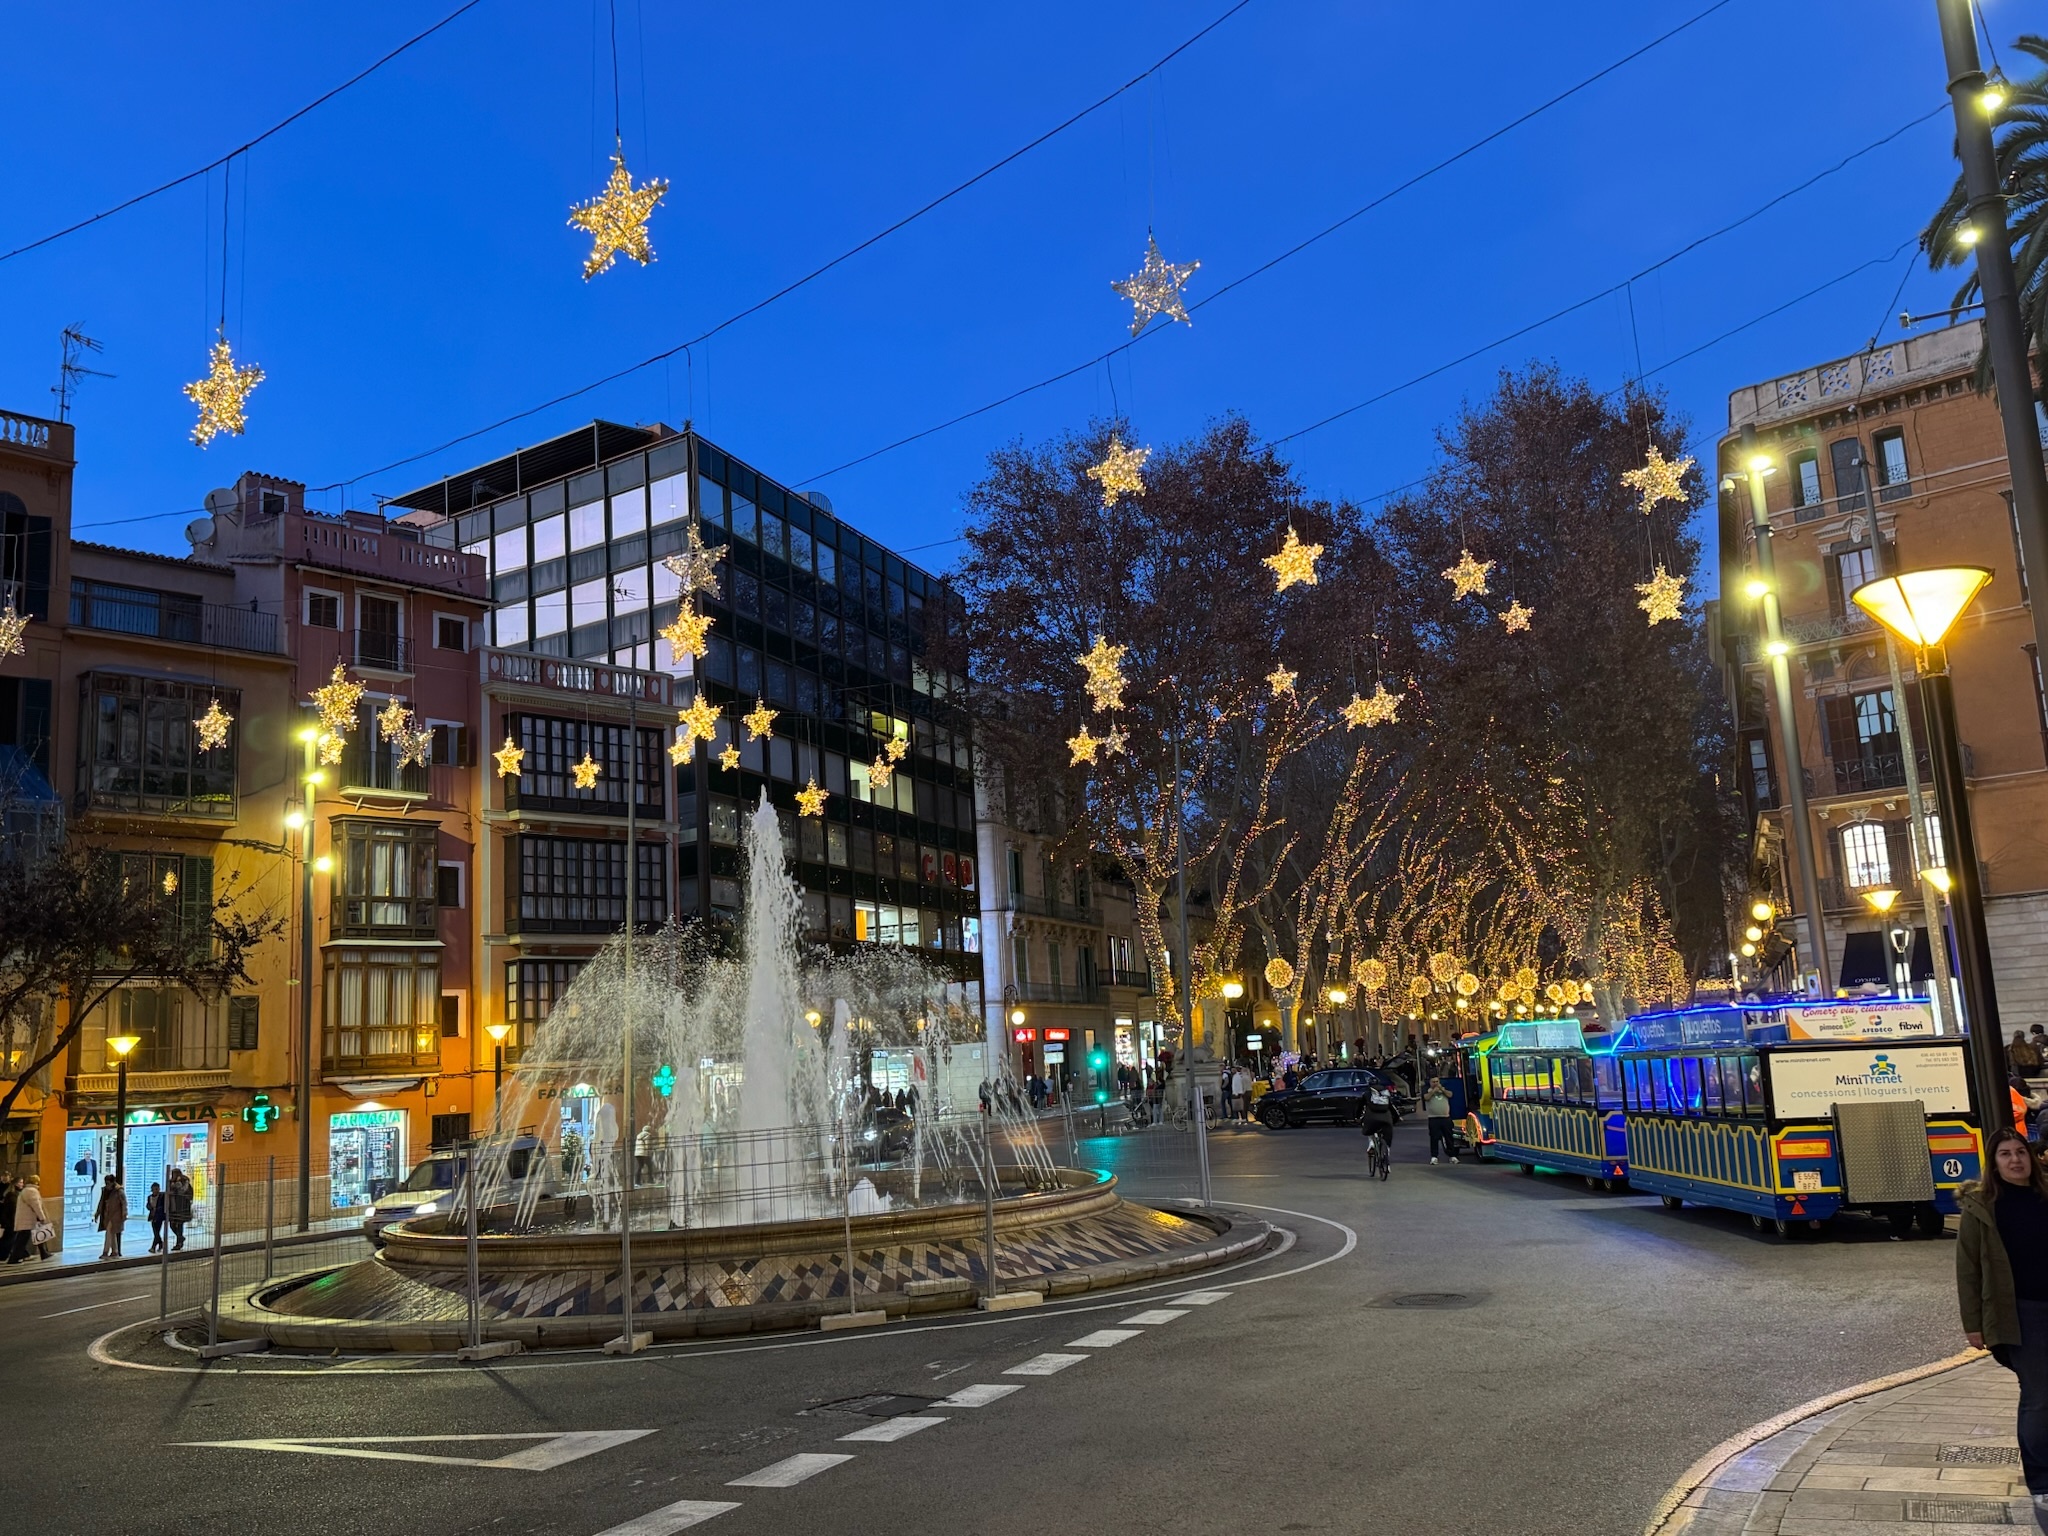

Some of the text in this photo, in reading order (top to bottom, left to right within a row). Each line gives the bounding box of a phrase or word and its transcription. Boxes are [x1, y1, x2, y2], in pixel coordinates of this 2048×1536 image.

[1802, 1006, 1838, 1018] Comerç
[1899, 1021, 1923, 1031] fibwi
[1835, 1074, 1903, 1086] MiniTrenet
[538, 1085, 624, 1099] FARMAA
[1790, 1085, 1950, 1098] concessions lloguers events
[67, 1105, 217, 1127] FARMACIA
[331, 1111, 400, 1127] FARMACIA
[1946, 1160, 1959, 1175] 24
